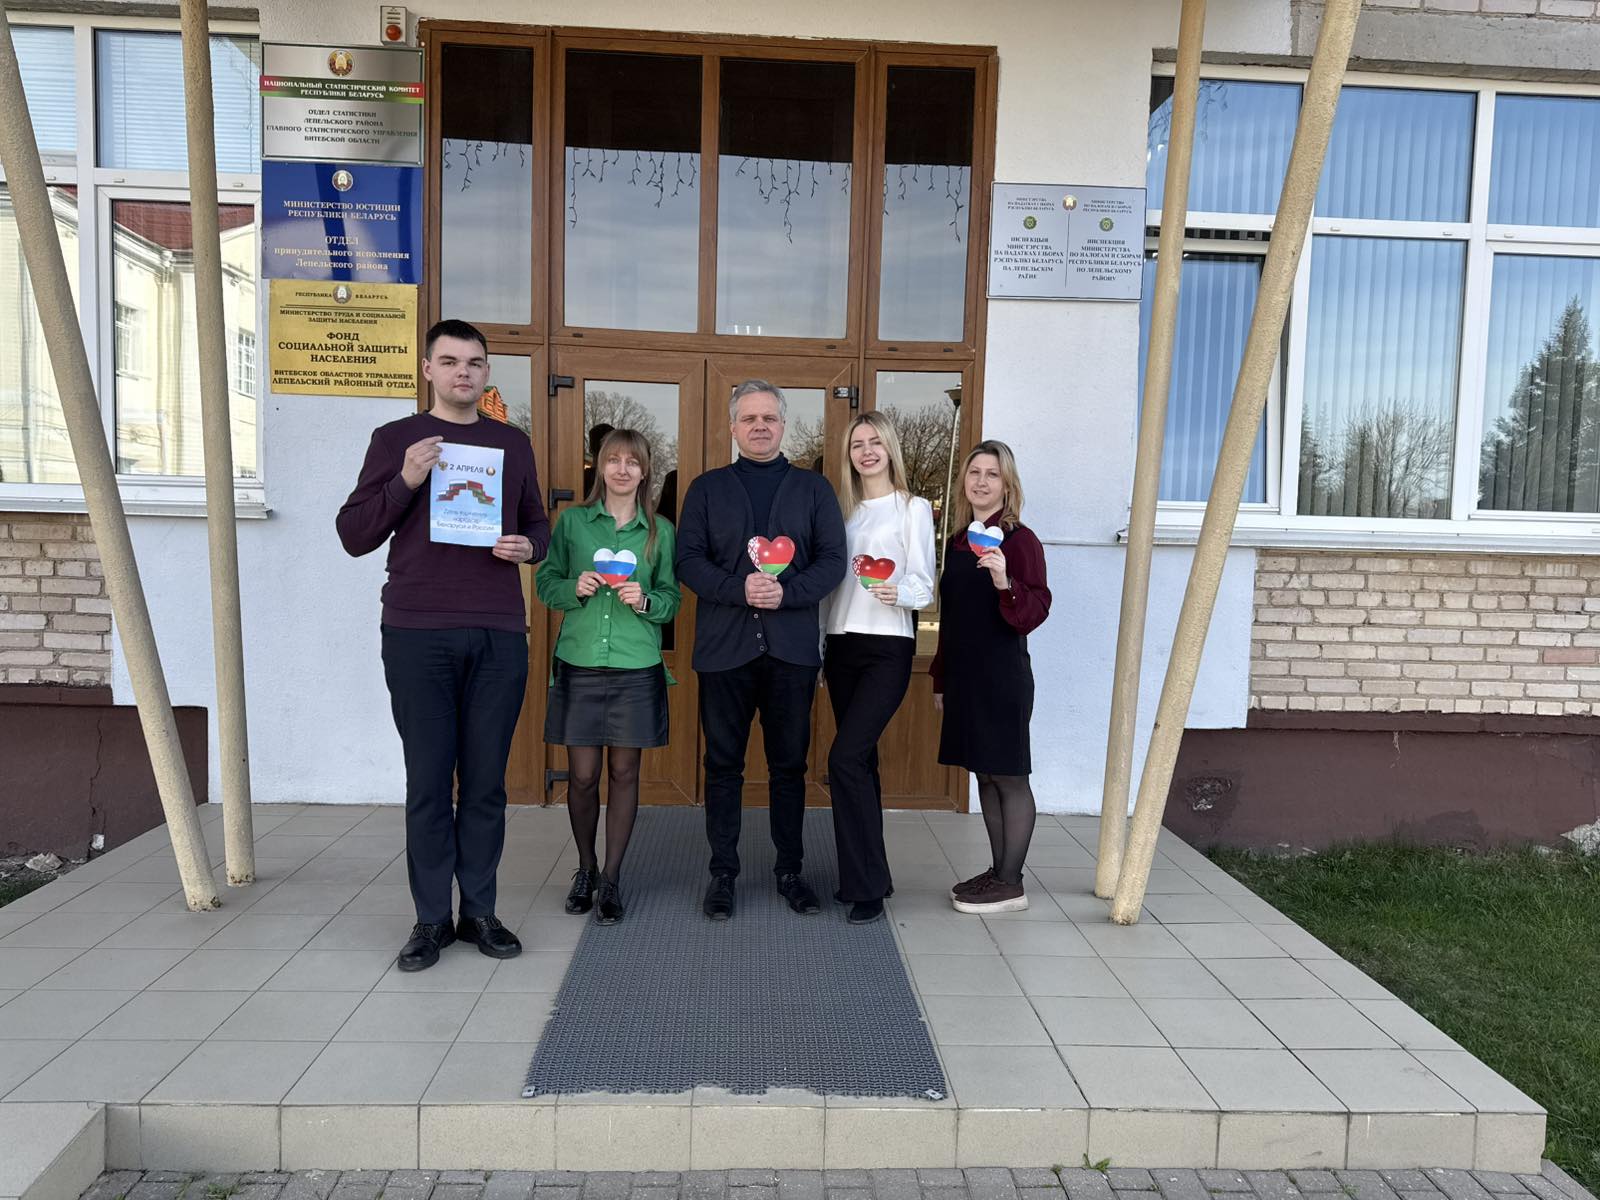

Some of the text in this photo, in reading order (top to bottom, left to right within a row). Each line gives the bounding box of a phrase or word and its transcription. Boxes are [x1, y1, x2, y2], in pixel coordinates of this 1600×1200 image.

[264, 80, 322, 88] НАЦИОНАЛЬНЫЙ
[325, 84, 386, 92] СТАТИСТИЧЕСКИЙ
[284, 200, 401, 212] МИНИСТЕРСТВО ЮСТИЦИИ
[288, 210, 396, 220] РЕСПУБЛИКИ БЕЛАРУСЬ
[325, 236, 358, 246] ОТДЕЛ
[274, 248, 409, 259] принудительного исполнения
[296, 258, 388, 270] Лепельского района
[327, 332, 359, 341] ФОНД
[278, 342, 408, 354] СОЦИАЛЬНОЙ ЗАЩИТЫ
[310, 354, 377, 364] НАСЕЛЕНИЯ
[333, 379, 383, 387] РАЙОННЫЙ
[456, 465, 484, 473] АПРЕЛЯ
